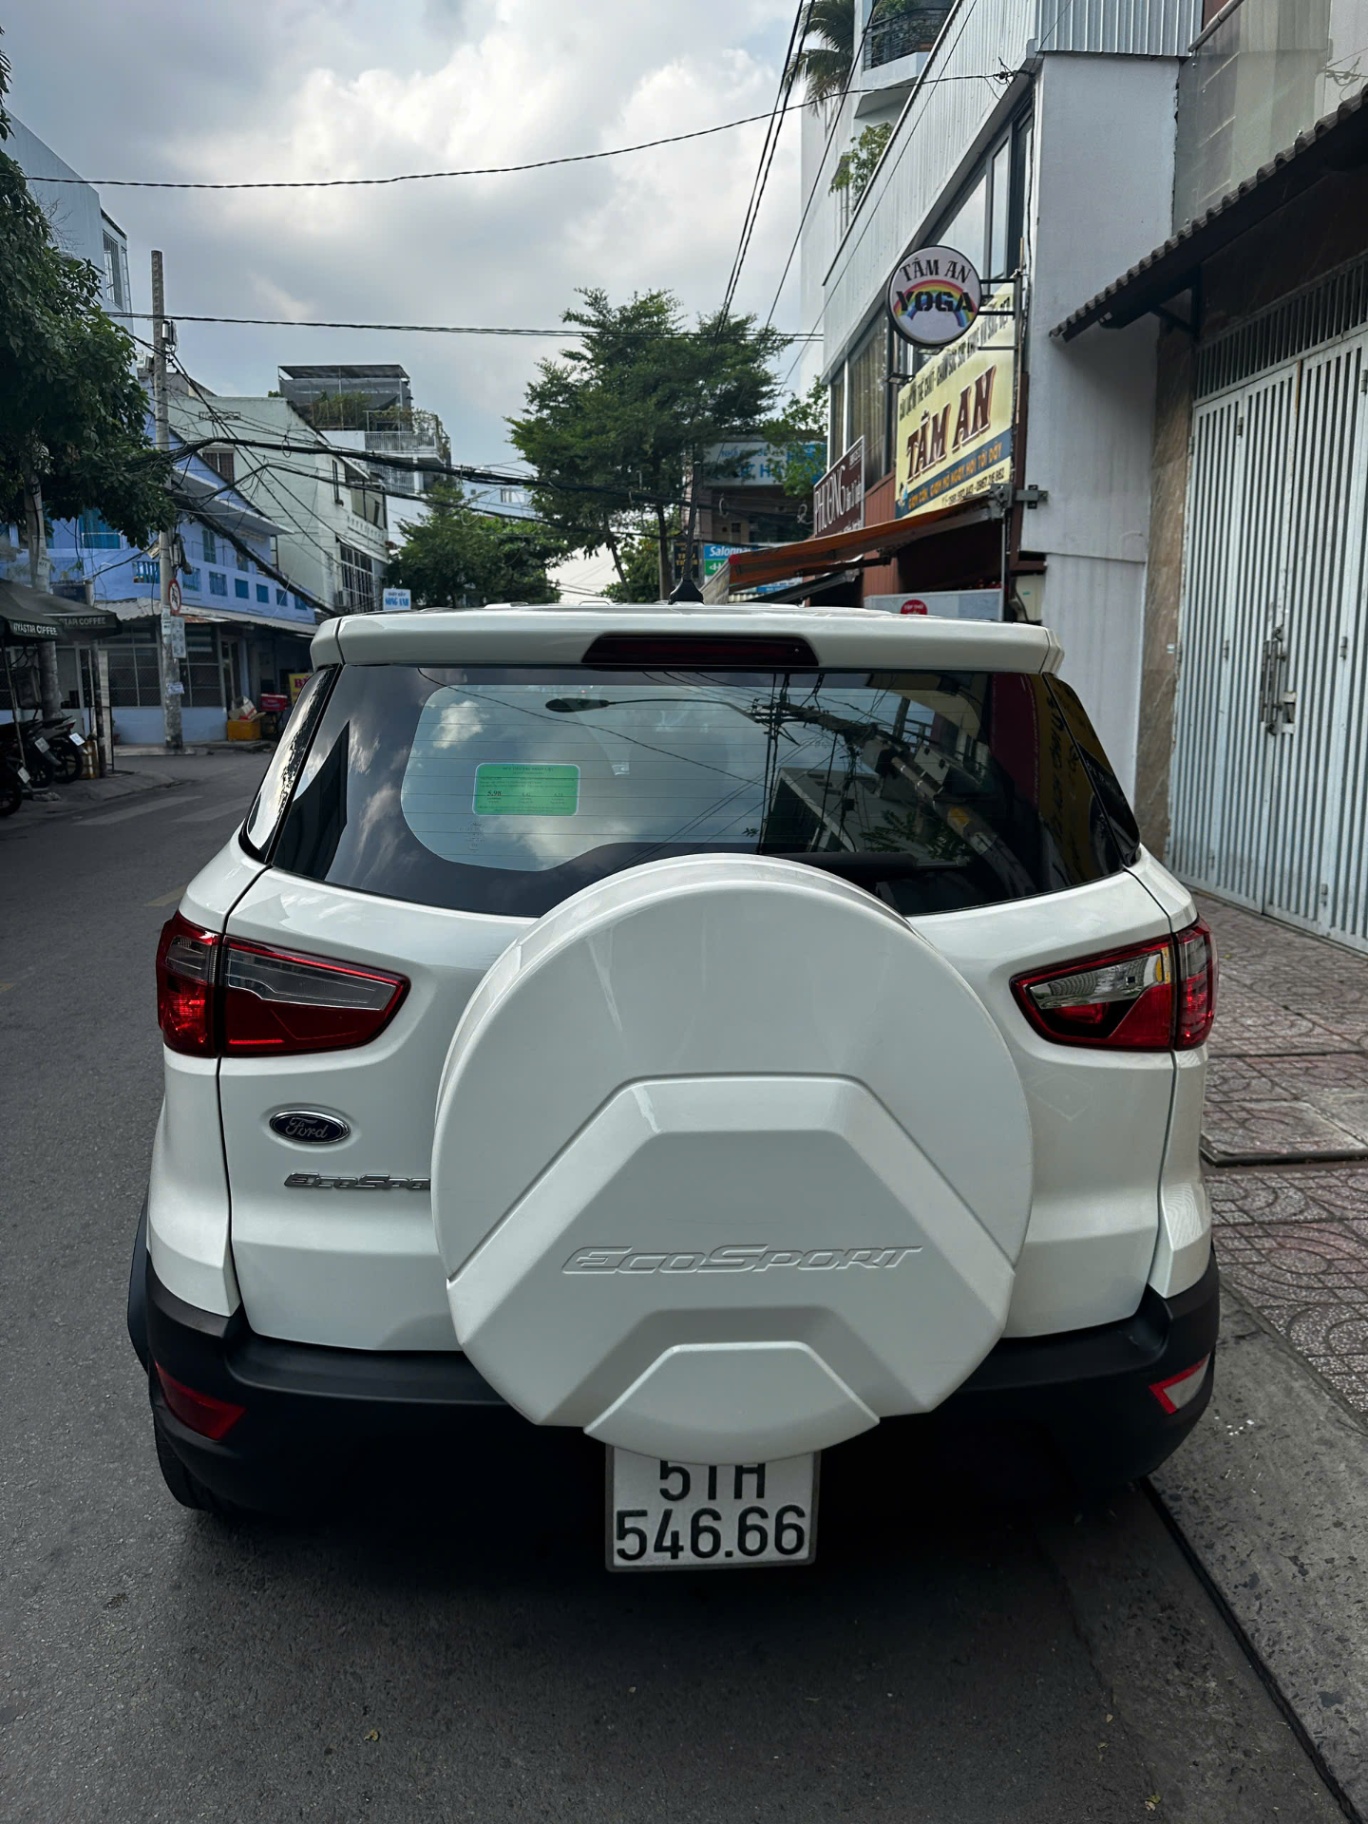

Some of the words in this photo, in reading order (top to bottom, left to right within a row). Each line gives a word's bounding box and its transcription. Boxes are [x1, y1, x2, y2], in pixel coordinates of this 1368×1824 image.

[900, 257, 940, 282] TÂM
[944, 260, 972, 283] AN
[896, 290, 975, 312] YOGA
[907, 409, 951, 484] TÂM
[952, 364, 997, 455] AN
[78, 616, 106, 626] COFFEE
[285, 1116, 329, 1139] Ford
[658, 1460, 767, 1501] 51H
[615, 1504, 807, 1561] 546.66
